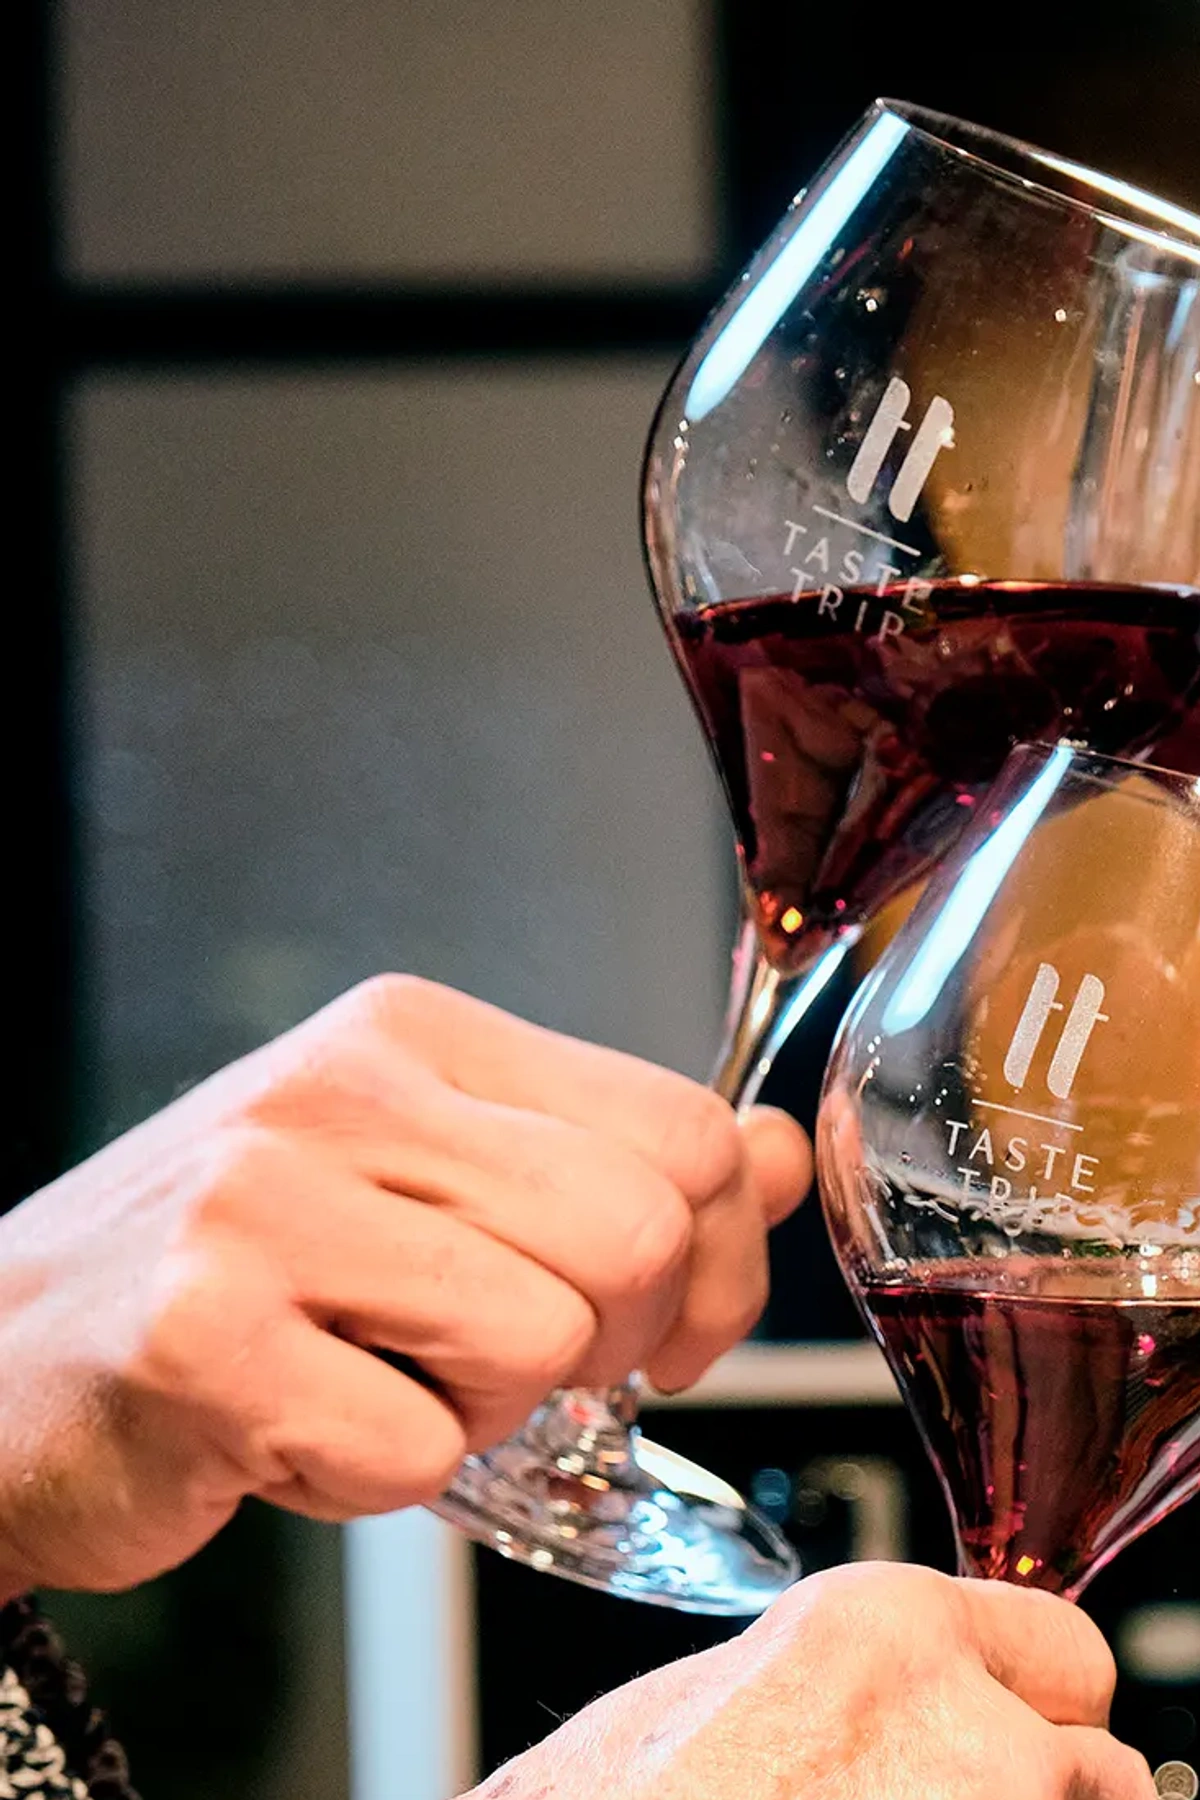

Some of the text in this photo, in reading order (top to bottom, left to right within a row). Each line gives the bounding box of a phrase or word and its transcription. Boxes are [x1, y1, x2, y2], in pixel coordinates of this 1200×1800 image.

[784, 520, 934, 615] TASTE
[789, 567, 904, 643] TRIP
[944, 1119, 1100, 1193] TASTE
